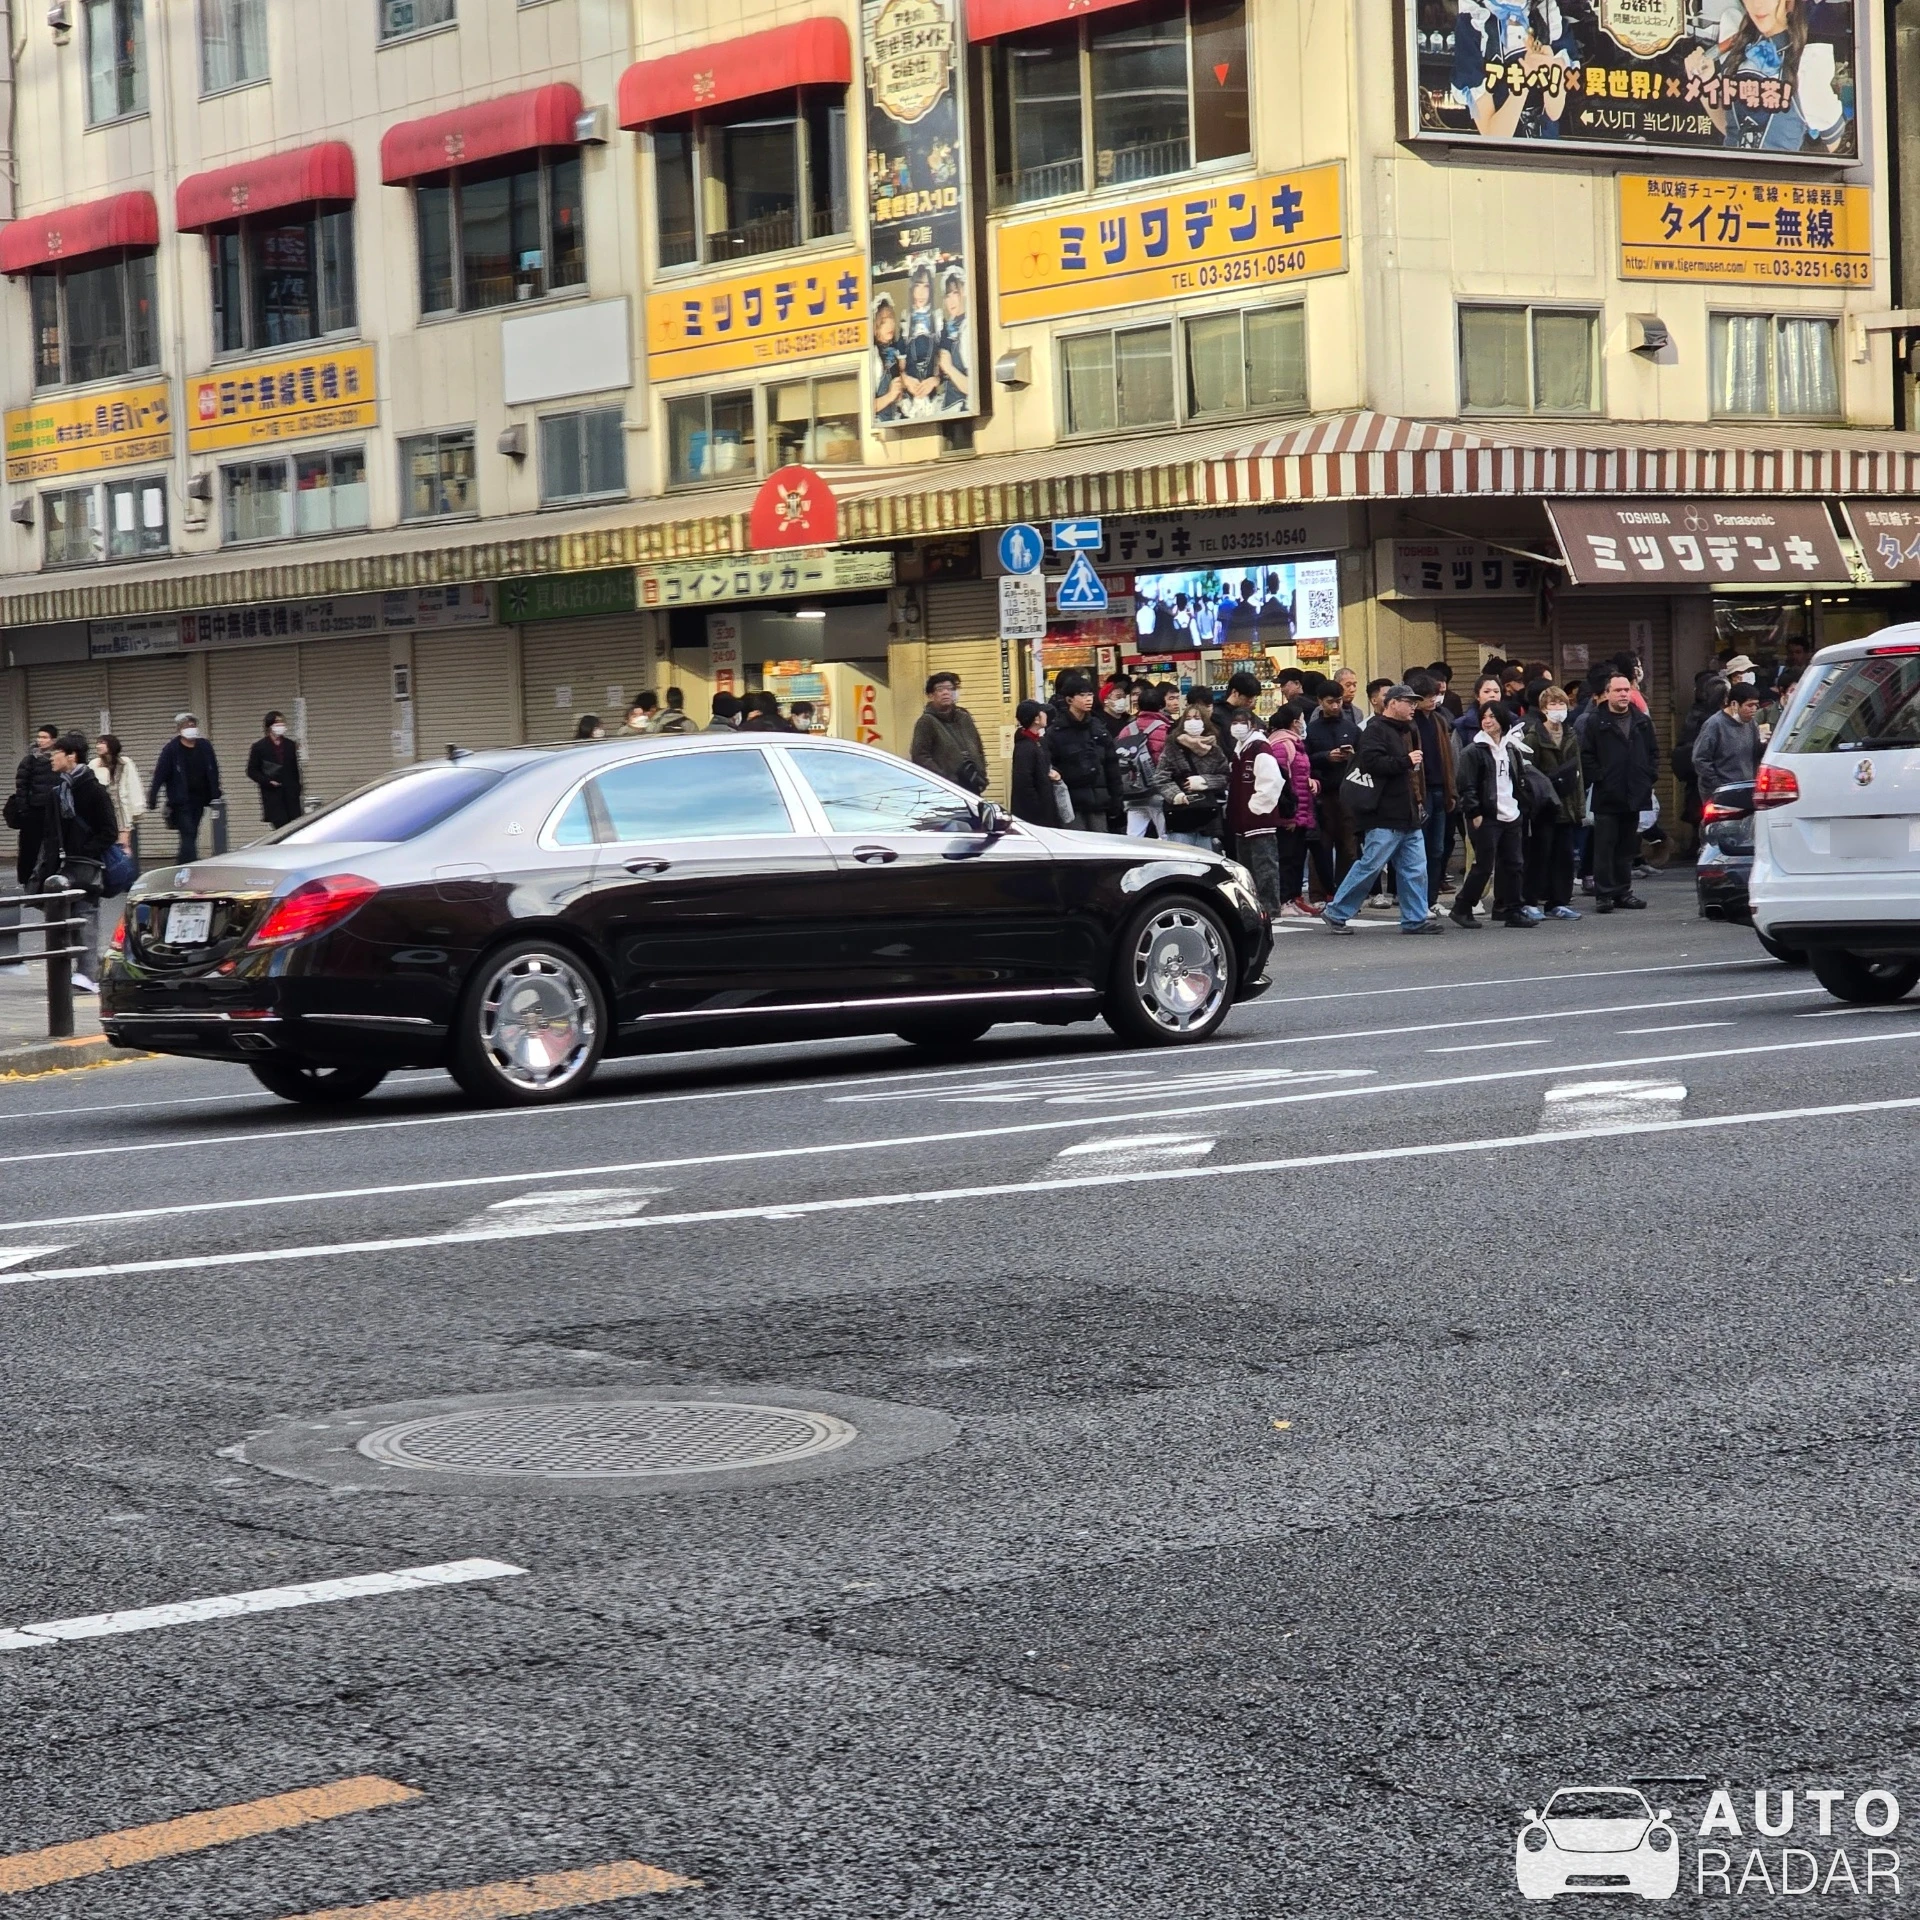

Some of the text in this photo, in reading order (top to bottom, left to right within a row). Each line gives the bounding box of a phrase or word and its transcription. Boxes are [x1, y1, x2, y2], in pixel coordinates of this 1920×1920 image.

[1594, 109, 1636, 131] 入り口
[1059, 183, 1305, 271] ミツワデンキ
[1659, 201, 1836, 249] タイガー無線
[1172, 249, 1307, 290] TEL 03-3251-0540
[1772, 258, 1869, 280] 03-3251-6313
[682, 270, 860, 337] ミツワデンキ
[31, 457, 59, 474] PARTS
[1616, 511, 1776, 527] TOSHIBA Panasonic
[1200, 527, 1307, 552] TEL 03-3251-0540
[1397, 545, 1441, 557] TOSHIBA
[1585, 534, 1820, 573] ミツワデンキ
[664, 565, 823, 601] コインロッカー
[198, 605, 289, 641] 田中無線電機
